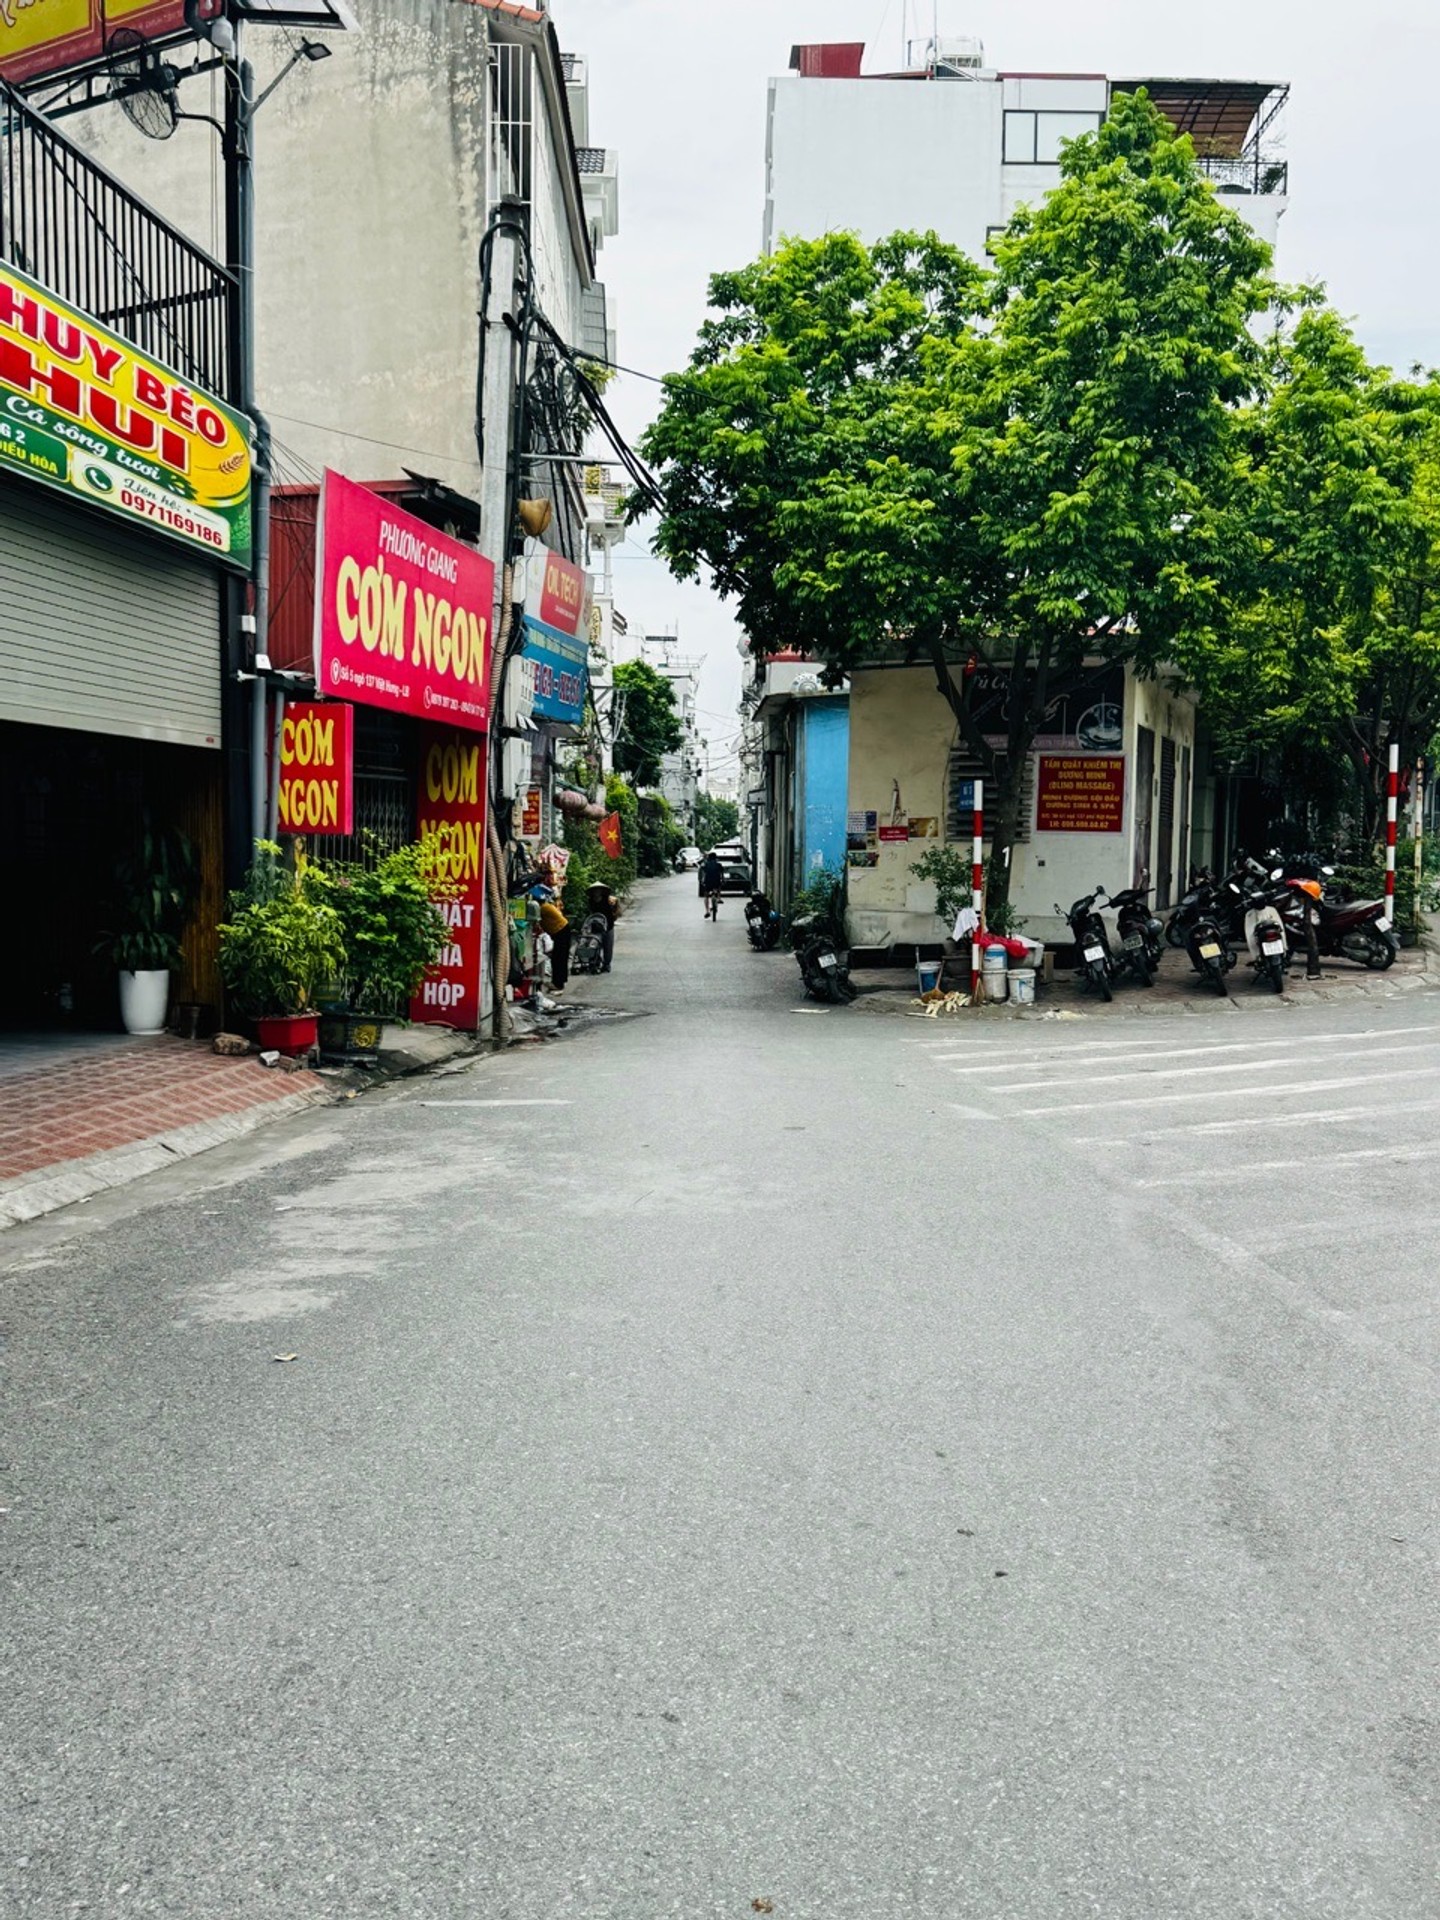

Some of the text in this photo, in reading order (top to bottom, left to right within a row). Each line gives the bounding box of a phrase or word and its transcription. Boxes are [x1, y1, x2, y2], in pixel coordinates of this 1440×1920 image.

[0, 281, 227, 446] HUY BÉO
[15, 429, 26, 444] 2
[53, 421, 108, 458] sông
[120, 489, 223, 546] 0971169186
[378, 519, 459, 584] PHƯƠNG GIANG
[336, 554, 487, 688] CƠM NGON
[281, 709, 335, 766] CƠM
[278, 779, 338, 827] NGON
[435, 895, 475, 928] HẤT
[423, 978, 465, 1011] HỘP
